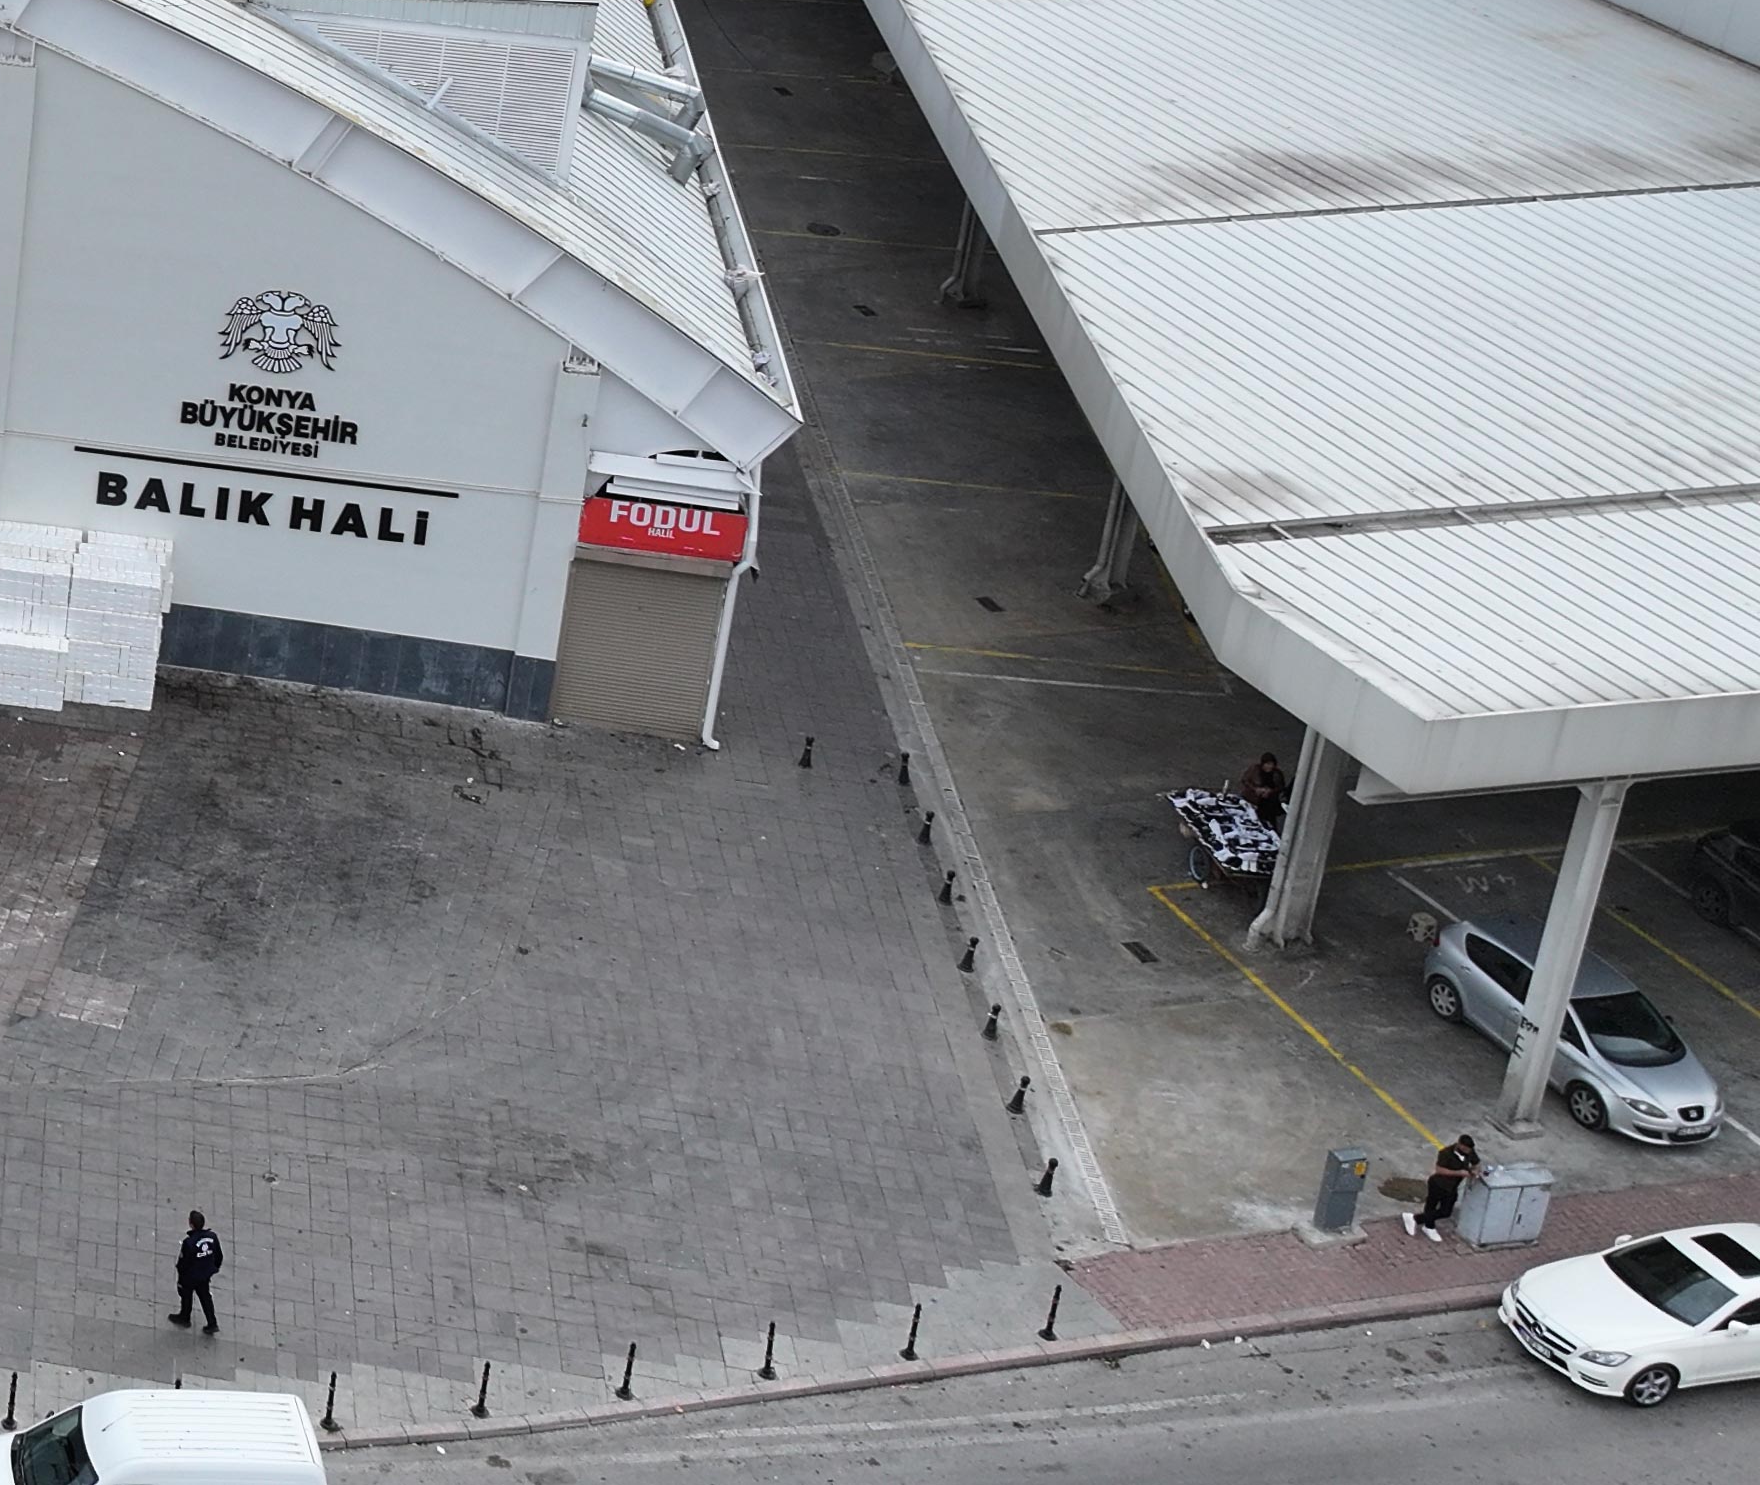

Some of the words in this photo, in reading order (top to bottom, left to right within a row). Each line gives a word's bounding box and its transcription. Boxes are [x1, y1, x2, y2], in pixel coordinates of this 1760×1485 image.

[228, 382, 316, 413] KONYA
[180, 398, 359, 445] BÜYÜKŞEHİR
[214, 432, 319, 459] BELEDİYESİ
[96, 470, 274, 527] BALIK
[289, 495, 430, 546] HALİ
[609, 500, 721, 536] FODUL
[647, 527, 676, 540] HALİL
